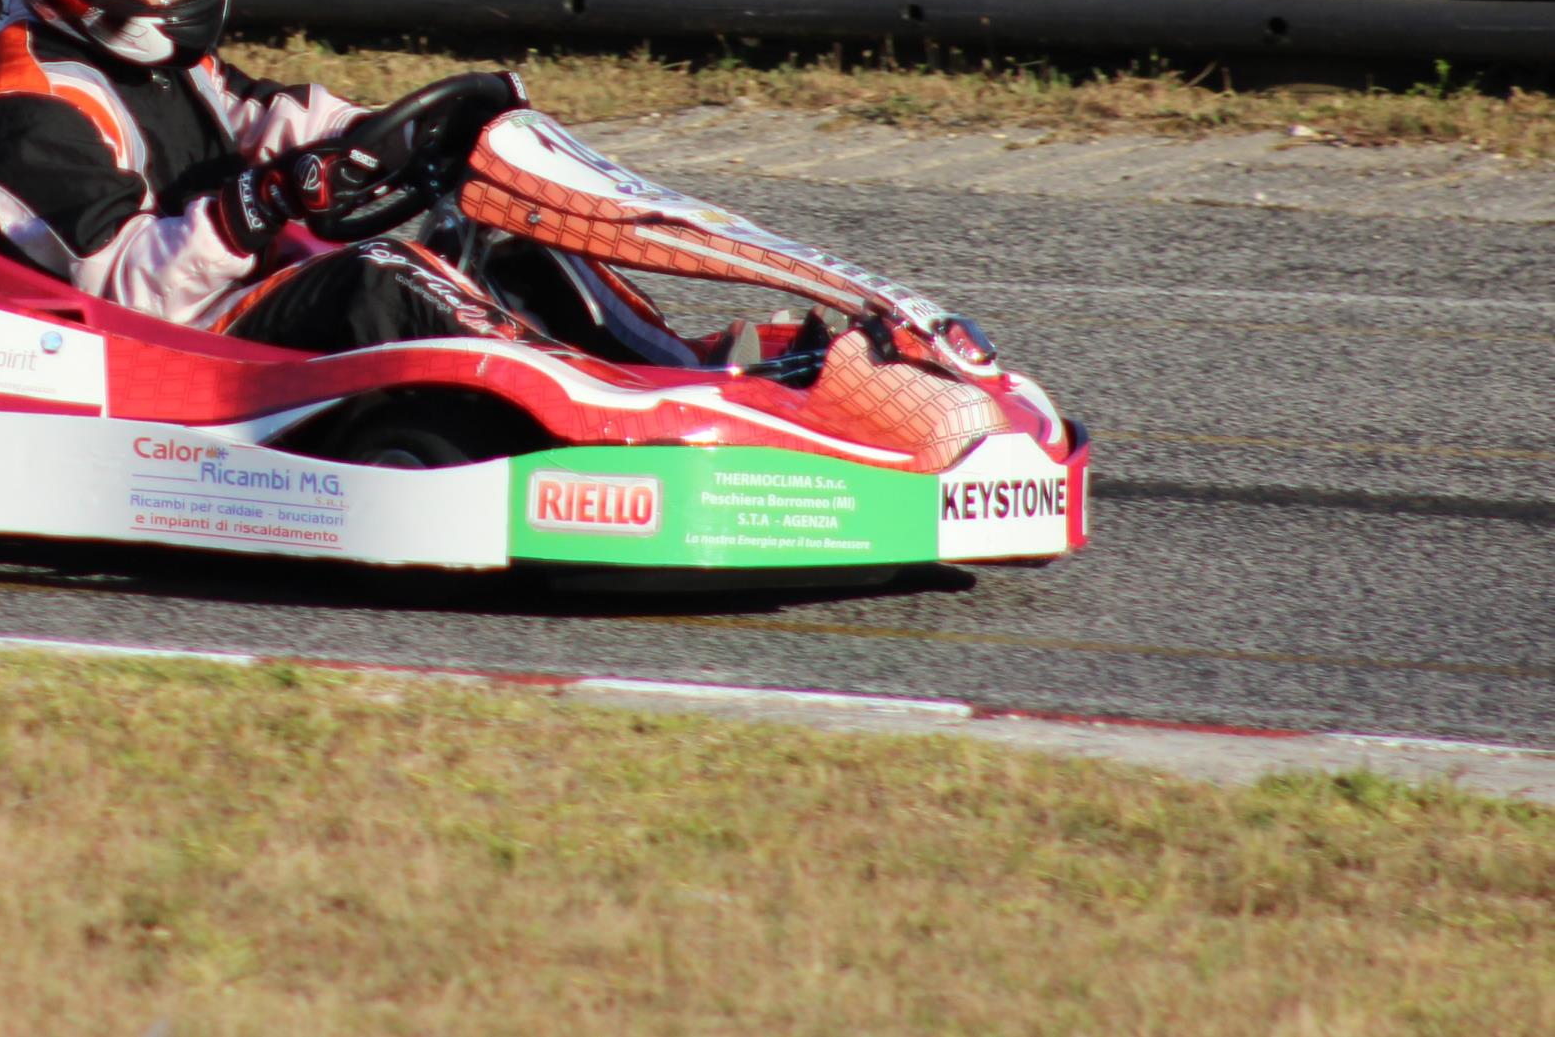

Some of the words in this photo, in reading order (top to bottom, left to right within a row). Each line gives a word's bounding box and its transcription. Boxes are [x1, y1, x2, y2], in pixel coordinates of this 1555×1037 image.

[132, 436, 204, 463] Calor
[200, 461, 290, 492] Ricambi
[300, 471, 345, 497] M.G.
[714, 471, 813, 489] THERMOCLIMA
[129, 493, 185, 511] Ricambi
[190, 501, 213, 514] per
[217, 503, 263, 519] caldaie
[277, 508, 344, 526] bruciatori
[537, 479, 653, 526] RIELLO
[701, 491, 766, 507] Peschiera
[767, 494, 831, 509] Borromeo
[832, 496, 857, 512] (MI)
[941, 477, 1067, 521] KEYSTONE
[134, 513, 145, 524] e
[150, 511, 210, 529] impianti
[214, 518, 229, 532] di
[233, 520, 339, 543] riscaldamento
[782, 514, 839, 529] AGENZIA
[685, 532, 700, 544] La
[701, 533, 736, 546] nostra
[737, 534, 778, 549] Energia
[778, 537, 797, 550] per
[805, 538, 823, 550] tuo
[823, 538, 871, 551] Benessere
